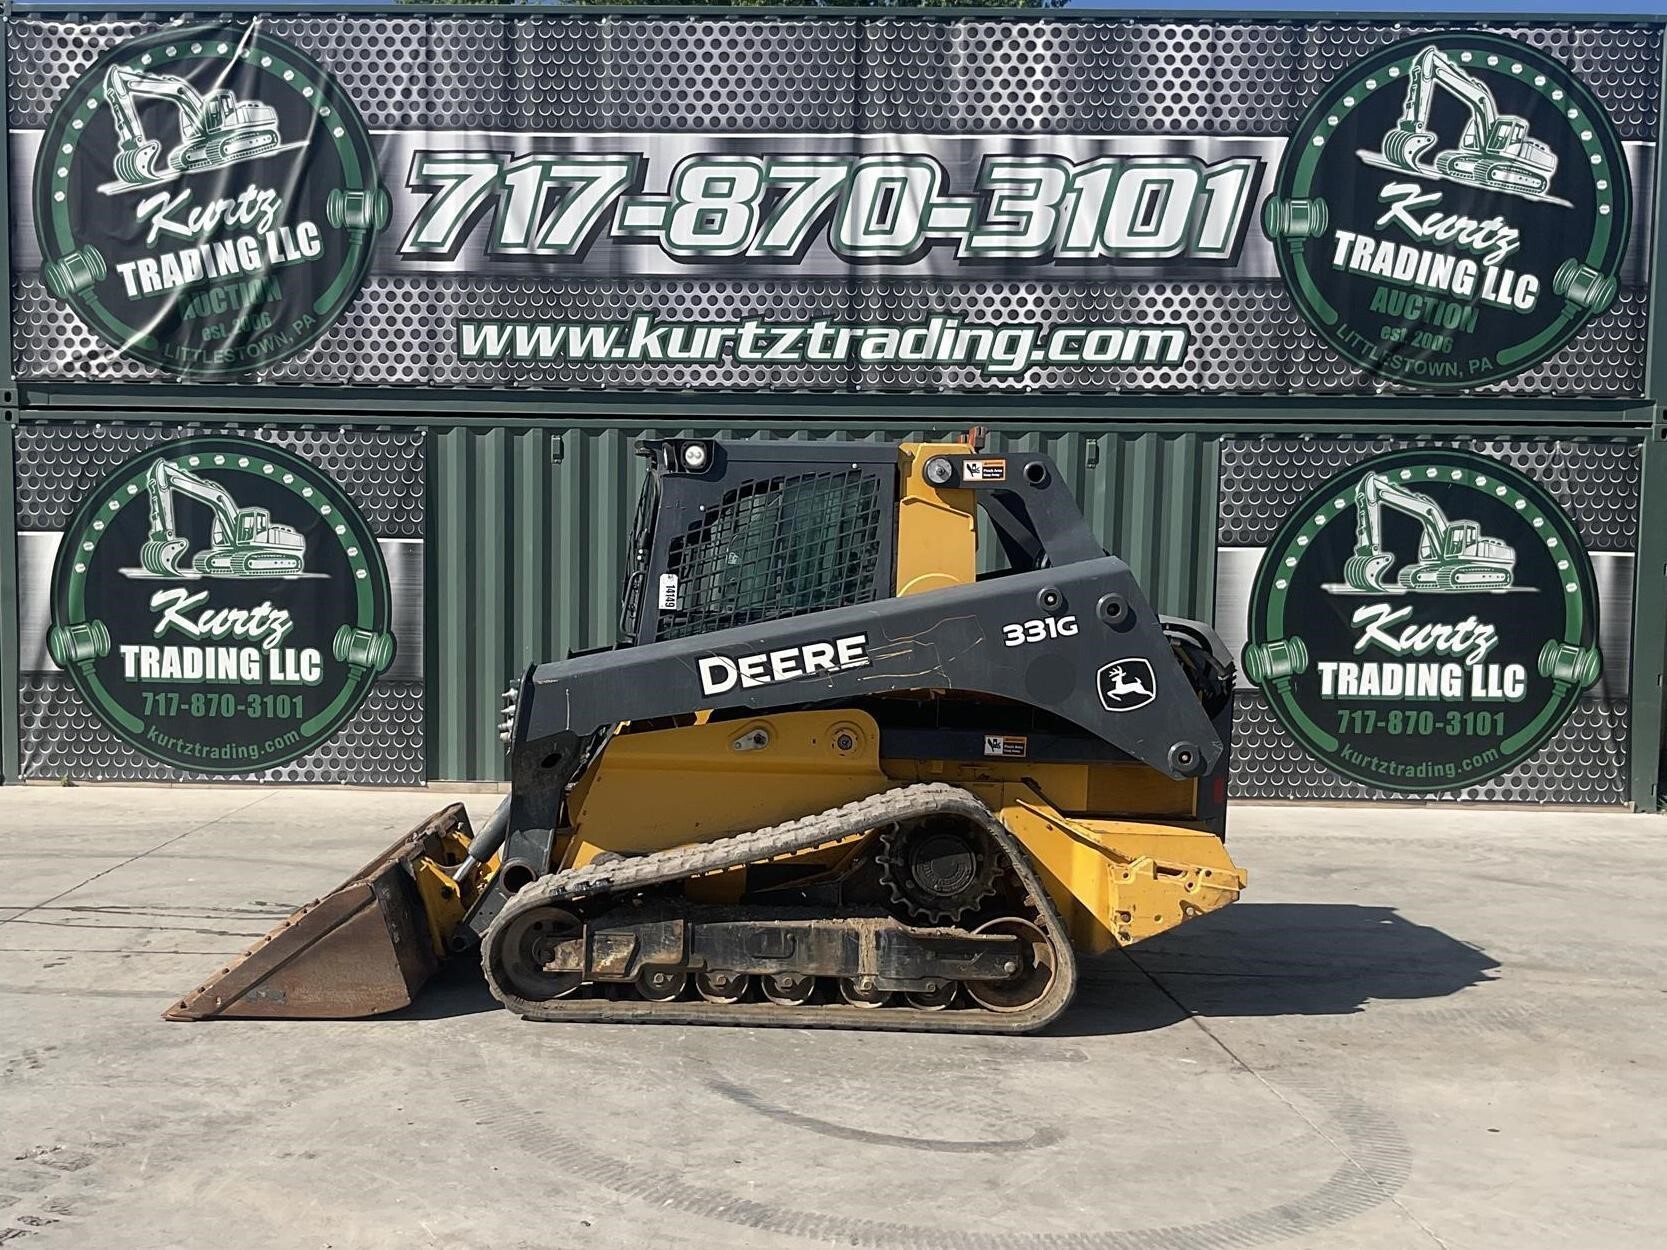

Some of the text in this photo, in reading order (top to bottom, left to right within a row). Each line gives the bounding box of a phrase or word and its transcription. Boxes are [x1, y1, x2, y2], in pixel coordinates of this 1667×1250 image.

[136, 184, 283, 246] Kurtz
[402, 152, 1260, 263] 717-870-3101
[1375, 181, 1520, 265] Kurtz
[116, 221, 322, 298] TRADING LLC
[1332, 230, 1540, 311] TRADING LLC
[179, 275, 282, 321] AUCTION
[1370, 286, 1479, 333] AUCTION
[292, 314, 316, 335] PA
[460, 315, 1188, 375] www.kurtztrading.com
[1411, 330, 1454, 353] 2006
[1469, 356, 1493, 374] PA
[150, 587, 293, 649] Kurtz
[1002, 616, 1079, 646] 331G
[1351, 603, 1498, 666] Kurtz
[120, 645, 323, 684] TRADING LLC
[698, 635, 869, 696] DEERE
[1318, 662, 1527, 701] TRADING LLC
[142, 692, 303, 718] 717-870-3101
[1337, 710, 1504, 736] 717-870-3101
[147, 726, 300, 760] kurtztrading.com
[1341, 743, 1499, 778] kurtztrading.com
